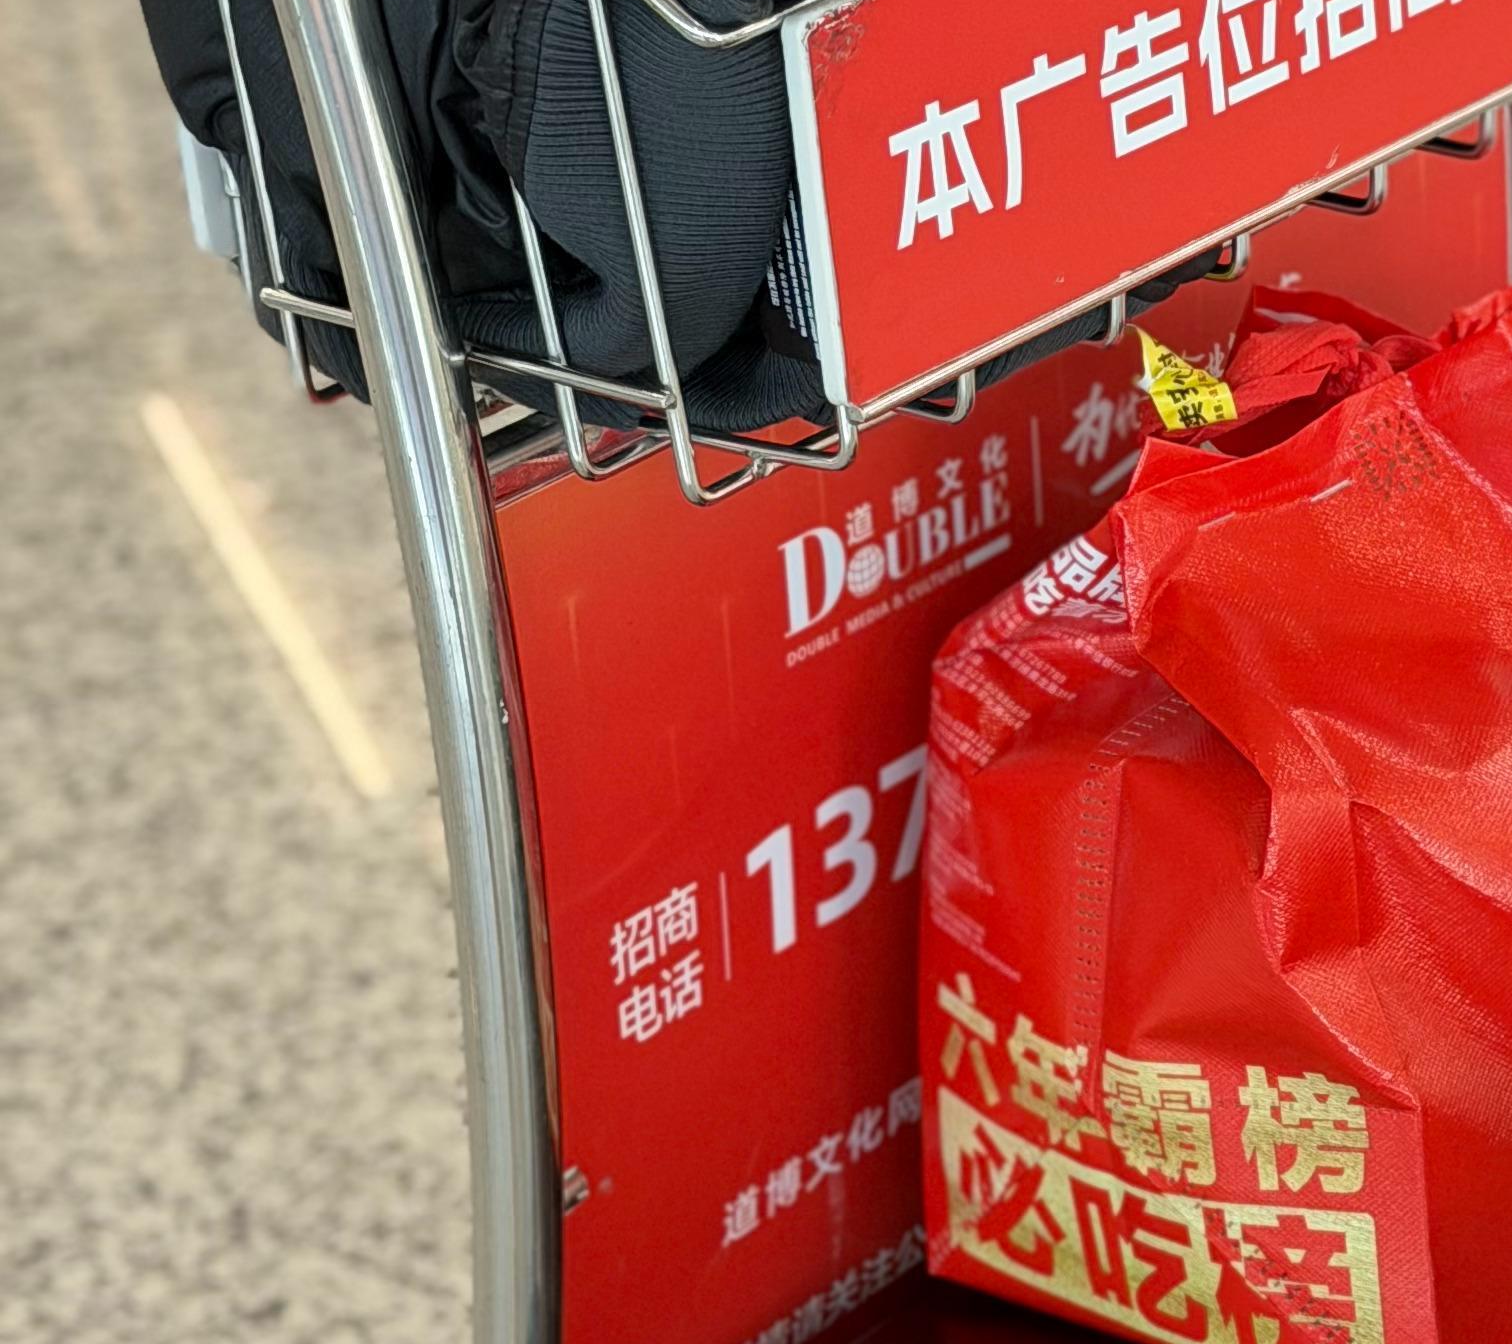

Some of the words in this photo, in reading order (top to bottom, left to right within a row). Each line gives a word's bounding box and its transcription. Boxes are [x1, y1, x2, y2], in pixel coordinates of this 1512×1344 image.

[786, 627, 841, 669] DOUBLE
[846, 600, 890, 635] MEDIA
[744, 742, 928, 957] 137
[607, 880, 699, 987] 招商
[617, 950, 704, 1045] 电话
[937, 971, 1371, 1194] 六年霸榜
